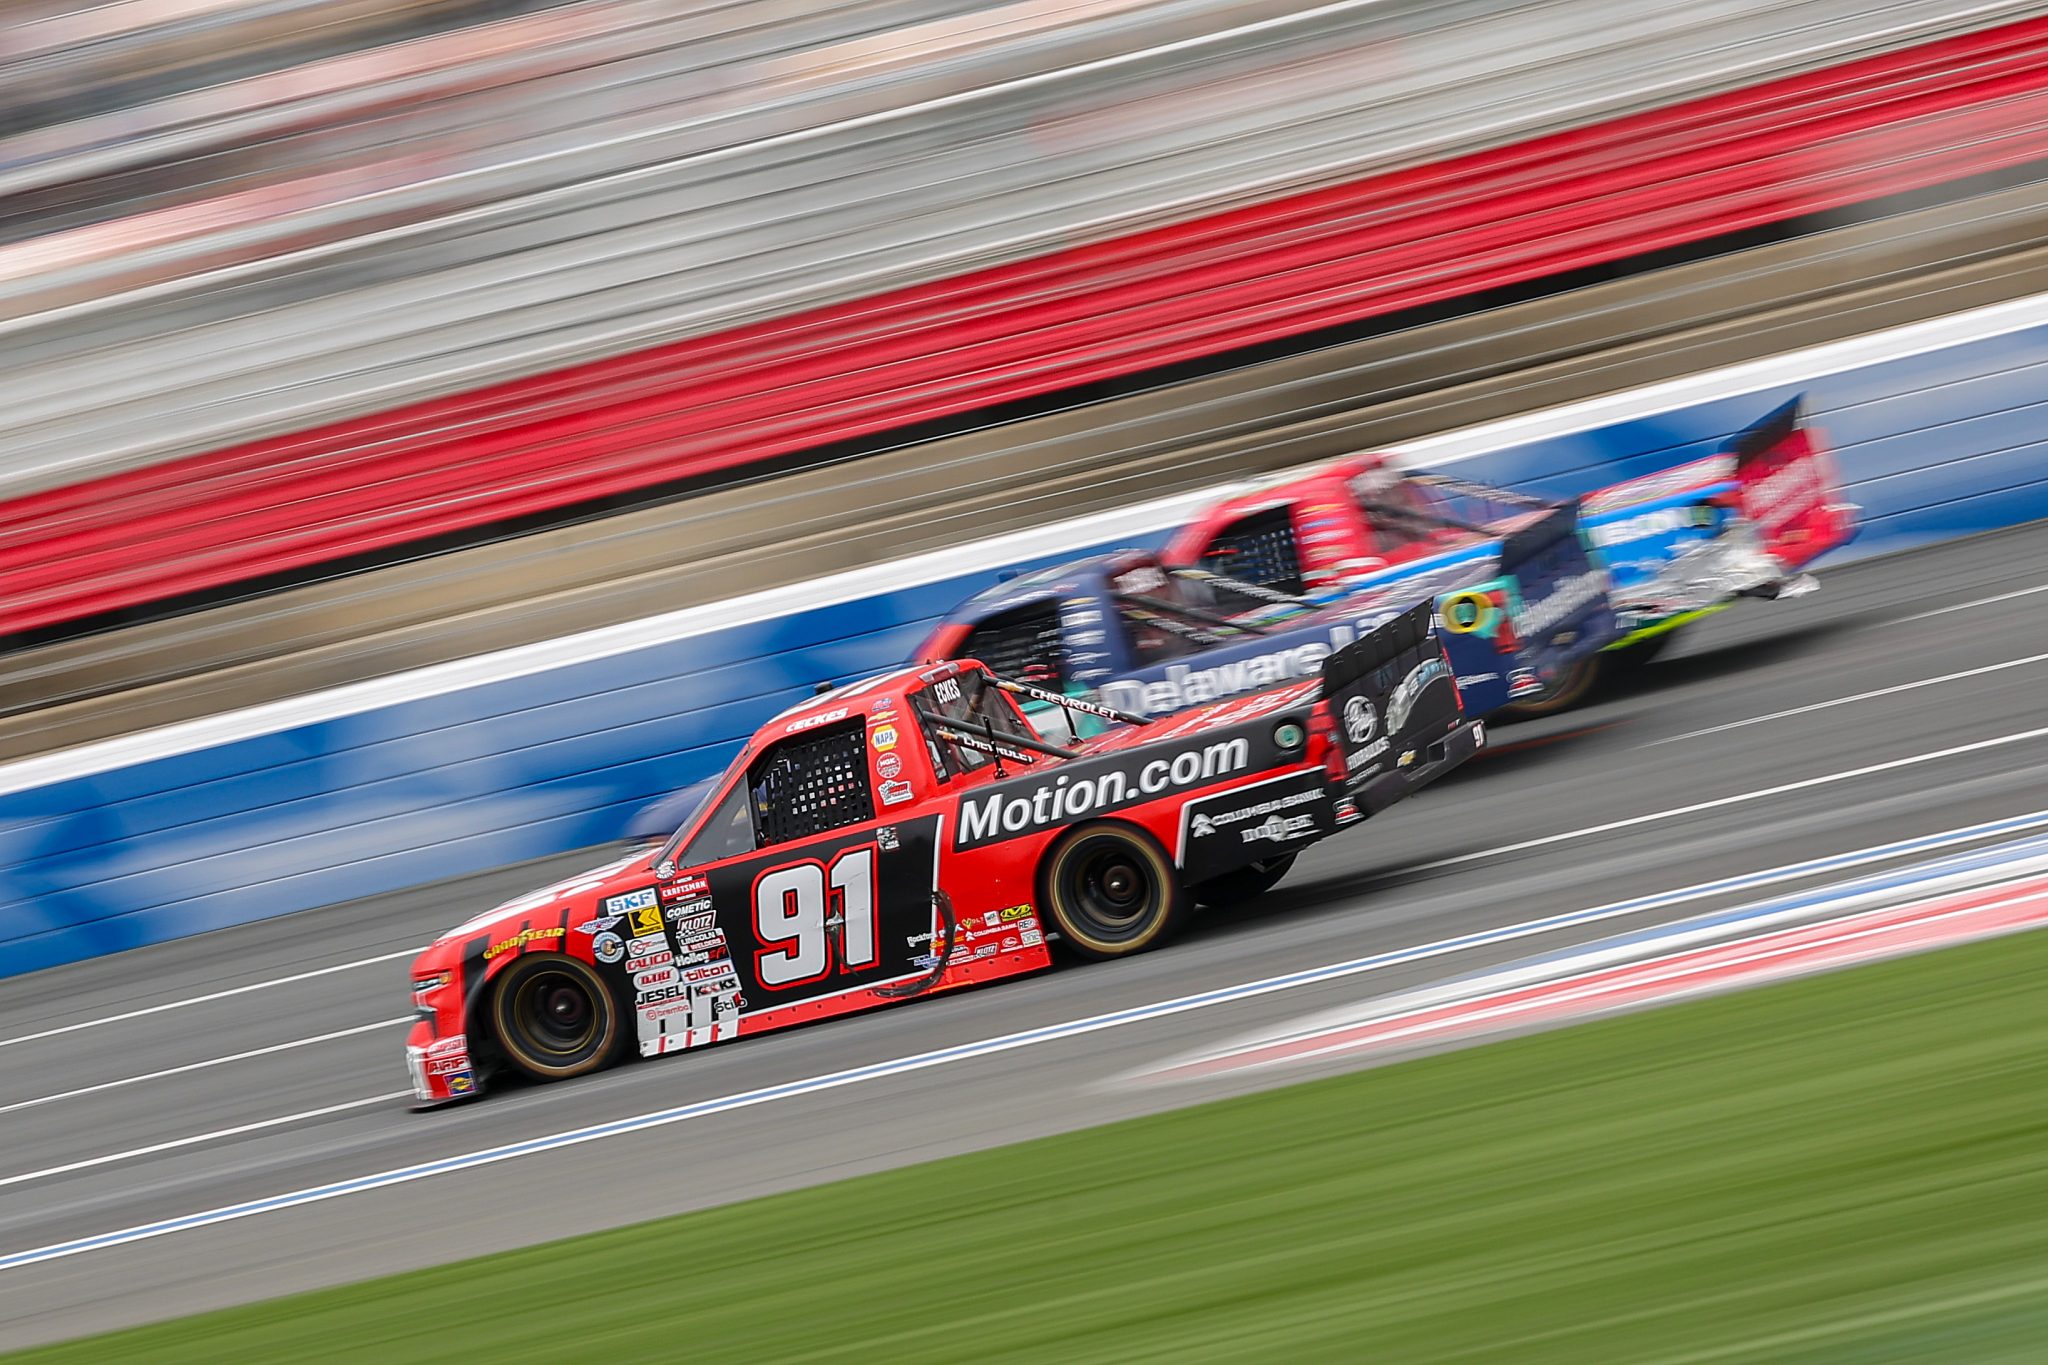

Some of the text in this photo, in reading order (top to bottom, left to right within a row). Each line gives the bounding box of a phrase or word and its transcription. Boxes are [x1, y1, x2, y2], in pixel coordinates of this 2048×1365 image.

[934, 677, 961, 705] ECKES
[1101, 642, 1333, 719] Delaware
[1030, 688, 1119, 720] CHEVROLET
[874, 730, 895, 746] NAPA
[958, 737, 1249, 844] Motion.com
[662, 880, 707, 897] CRAFTSMAN
[609, 891, 653, 913] SKF
[666, 899, 711, 919] COMETIC
[681, 914, 712, 931] KLOTZ
[754, 845, 876, 987] 91
[482, 926, 566, 960] GOODYEAR
[681, 931, 716, 946] LINCOLN
[627, 951, 671, 972] CALICO
[675, 949, 709, 967] Holley
[684, 964, 732, 982] tilton
[636, 985, 685, 1006] JESEL
[656, 1004, 690, 1018] brembo
